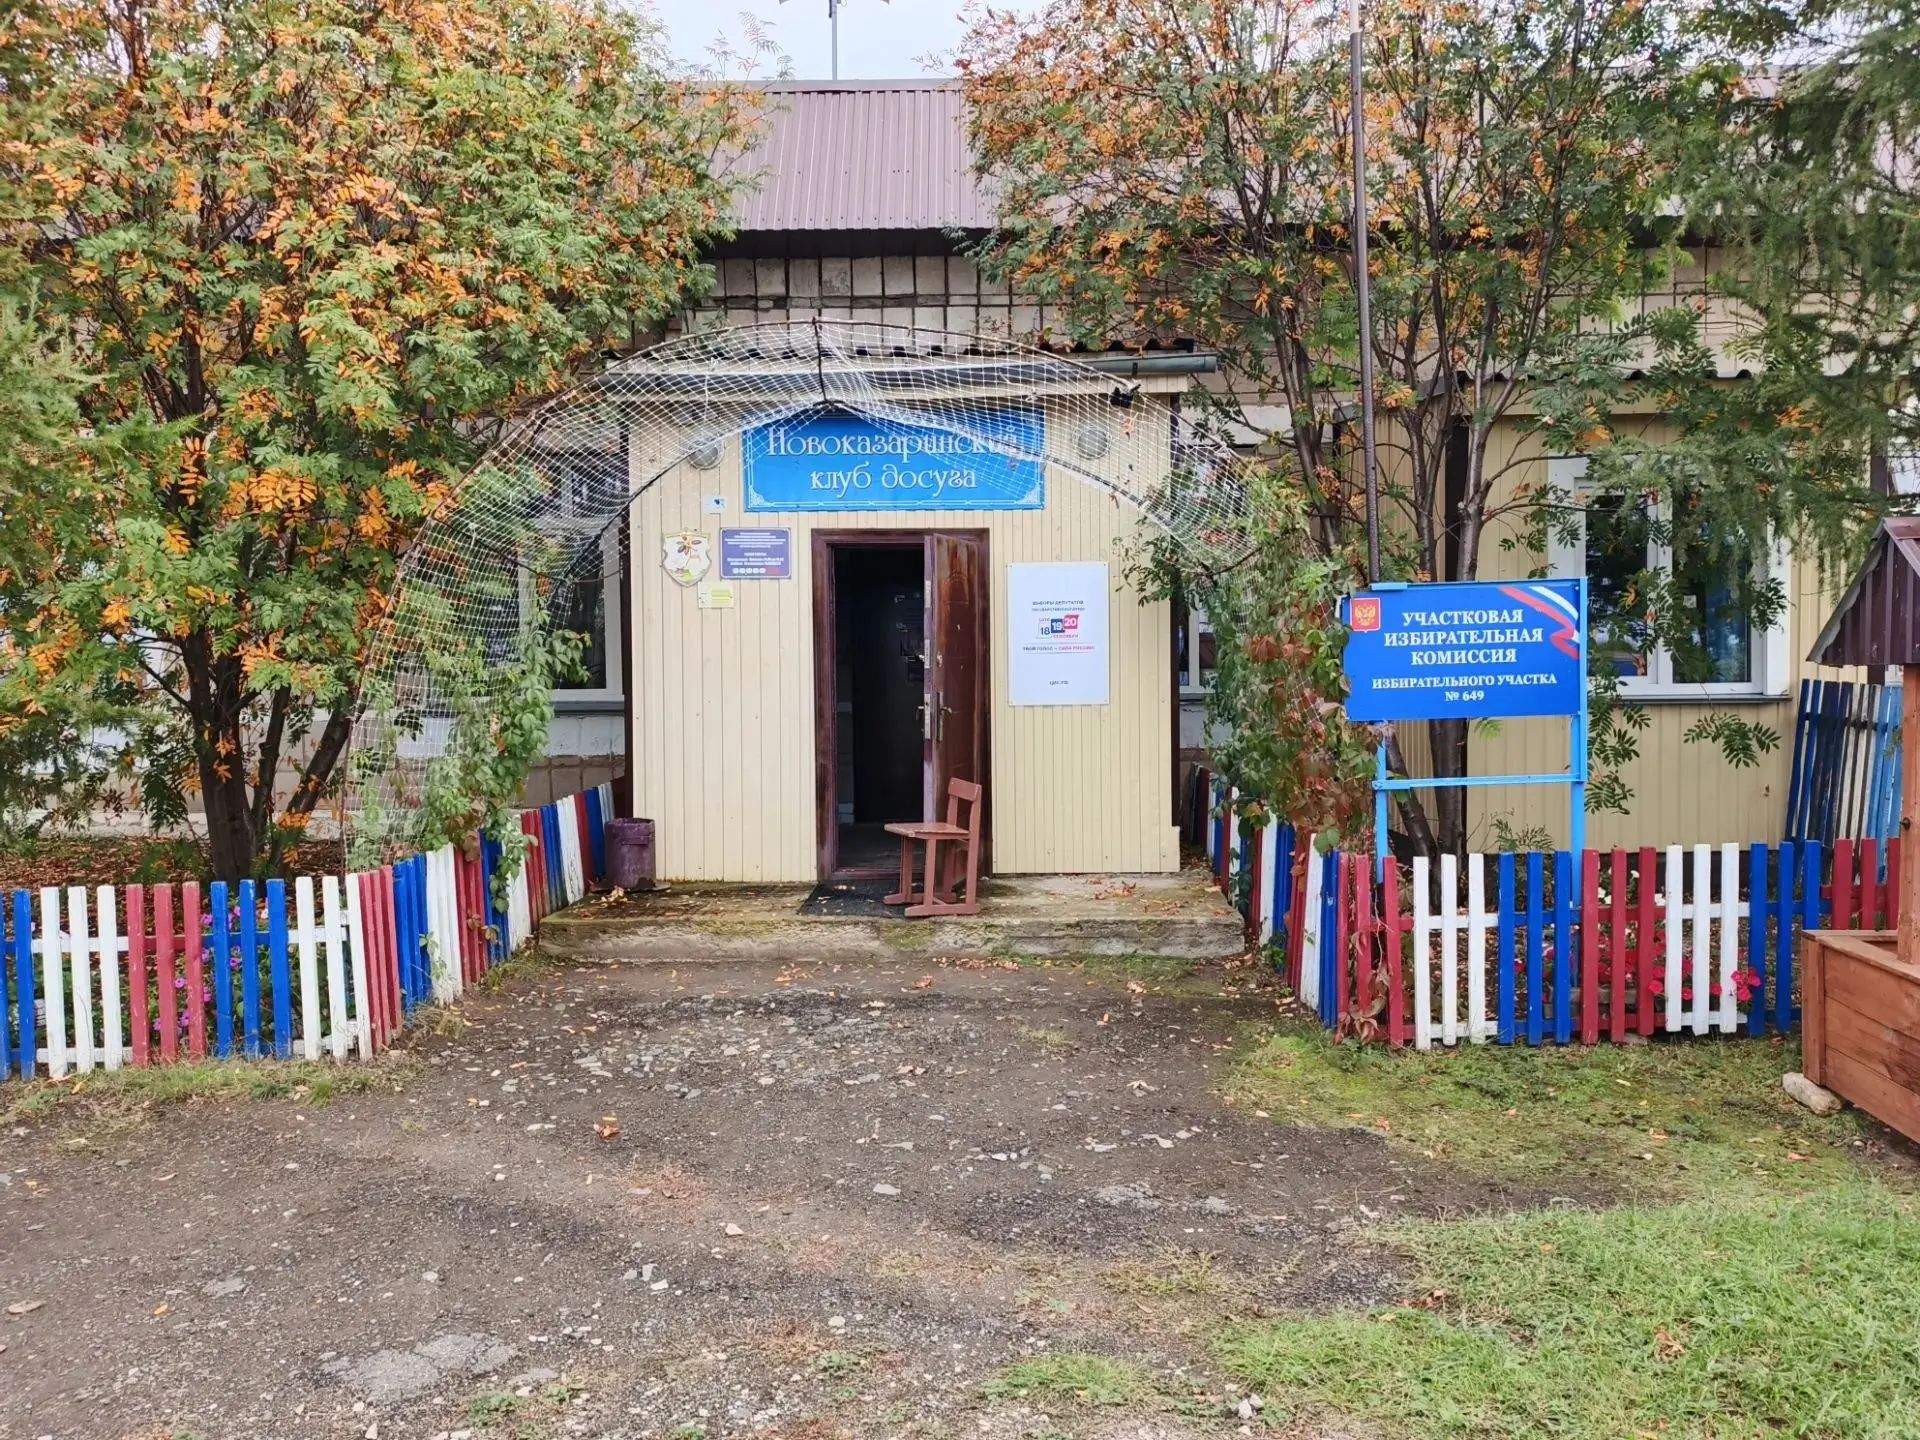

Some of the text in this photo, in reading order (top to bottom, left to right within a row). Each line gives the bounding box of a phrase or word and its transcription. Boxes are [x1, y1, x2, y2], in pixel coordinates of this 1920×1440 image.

[810, 461, 978, 498] клуб досуга
[1040, 617, 1077, 636] 18 19 20
[1402, 608, 1524, 627] УЧАСТКОВАЯ
[1383, 628, 1544, 647] ИЗБИРАТЕЛЬНАЯ
[1411, 648, 1518, 666] КОМИССИЯ
[1372, 673, 1558, 690] ИЗБИРАТЕЛЬНОГО УЧАСТКА
[1444, 690, 1485, 701] № 649
